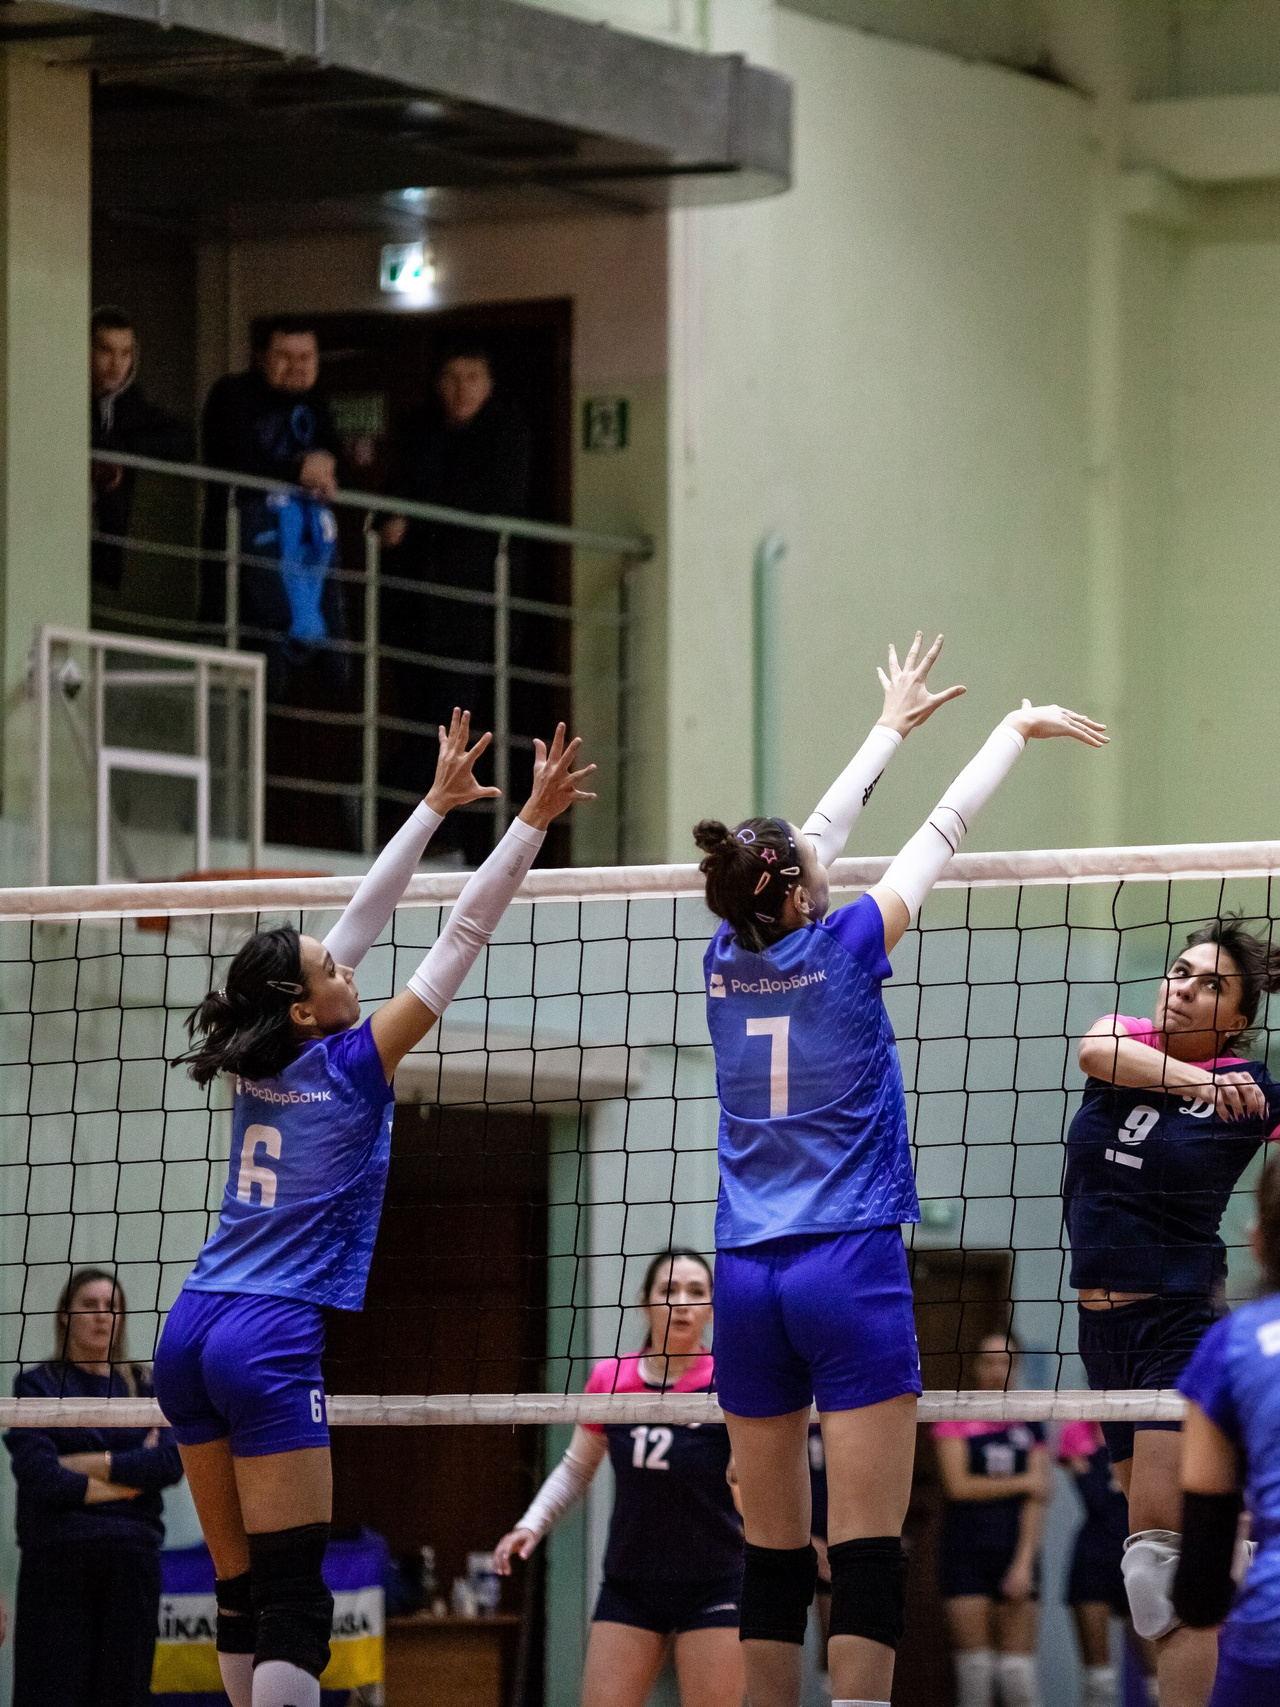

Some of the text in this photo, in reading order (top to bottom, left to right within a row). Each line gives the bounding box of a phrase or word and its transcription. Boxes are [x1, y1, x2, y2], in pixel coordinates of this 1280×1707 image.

[731, 970, 828, 995] РосДорБанк
[746, 1015, 790, 1119] 7
[244, 1081, 332, 1106] РосДорБанк
[1117, 1104, 1160, 1146] 9
[236, 1123, 282, 1208] 6
[310, 1389, 322, 1423] 6
[629, 1425, 675, 1471] 12
